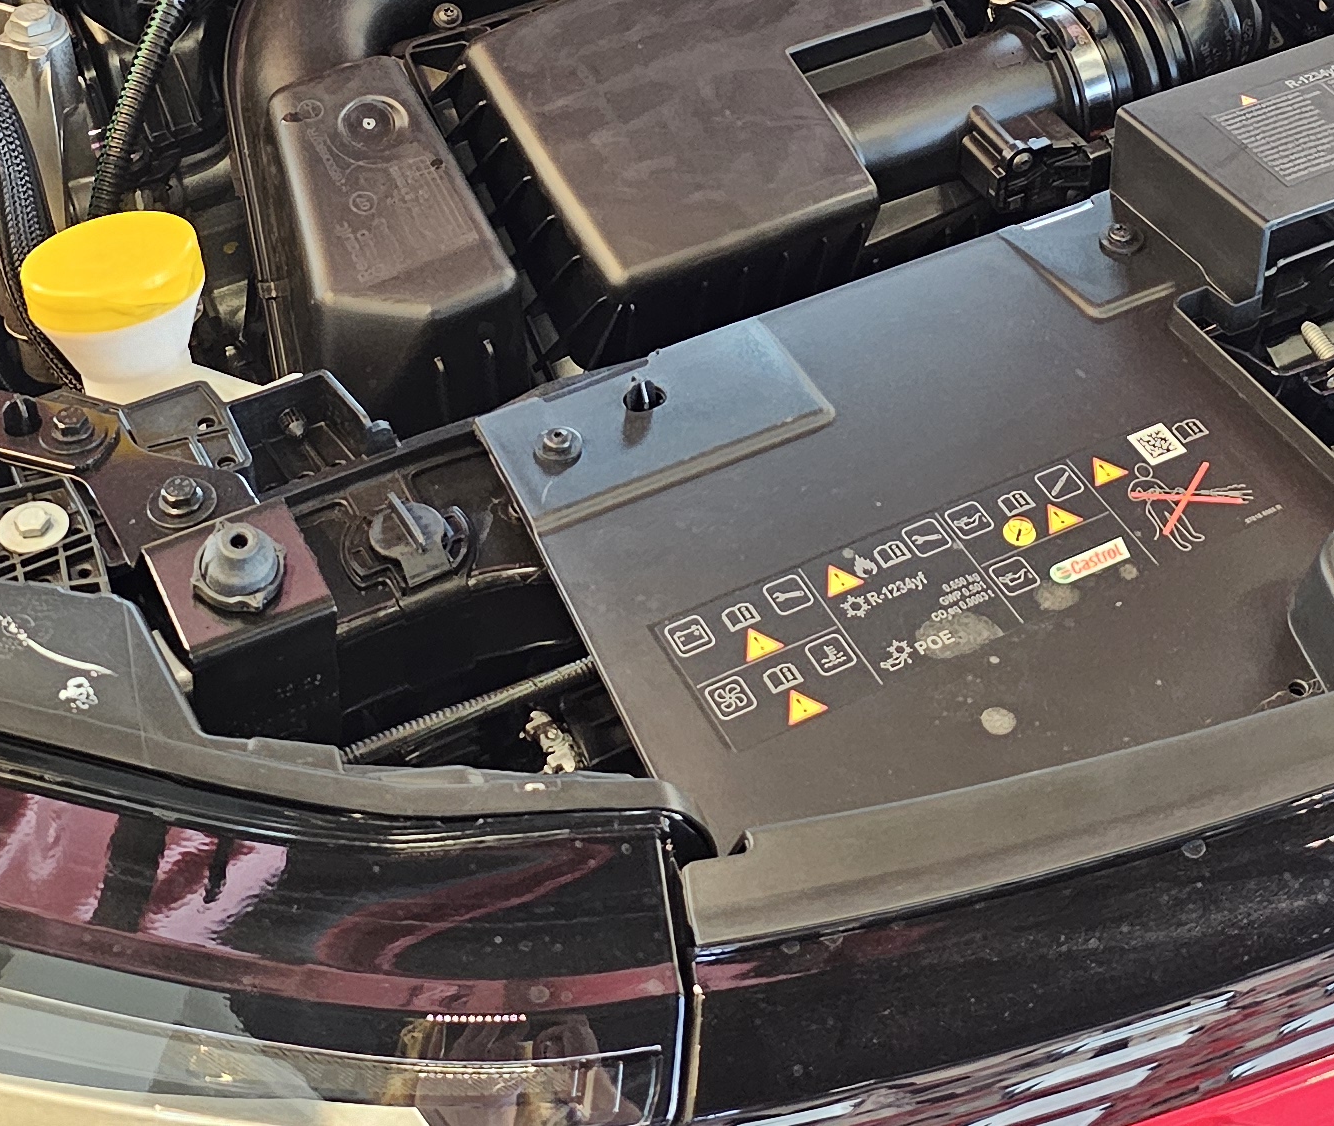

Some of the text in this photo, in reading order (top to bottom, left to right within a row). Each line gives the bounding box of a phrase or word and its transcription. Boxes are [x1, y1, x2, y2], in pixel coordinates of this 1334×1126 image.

[1070, 543, 1124, 574] Castrol
[866, 571, 928, 606] R-1234yf
[939, 581, 987, 606] GWP 0.501
[958, 591, 989, 610] 0.0003
[914, 630, 956, 655] POE
